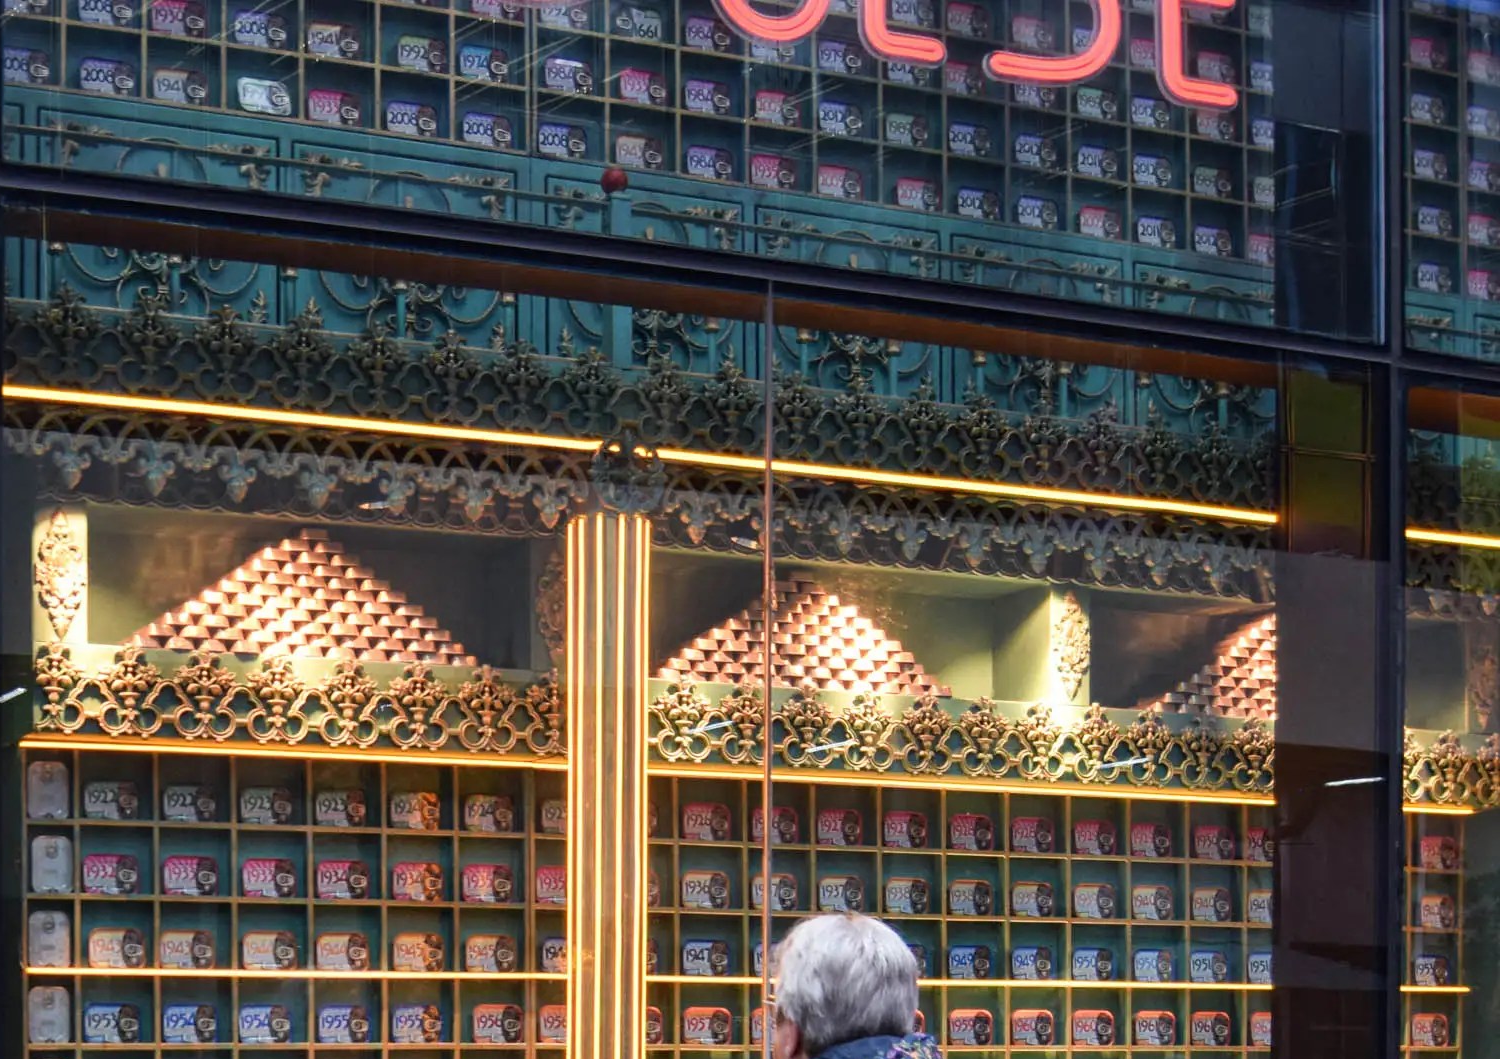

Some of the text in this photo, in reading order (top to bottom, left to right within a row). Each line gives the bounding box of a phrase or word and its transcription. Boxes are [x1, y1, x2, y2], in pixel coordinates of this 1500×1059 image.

[81, 0, 111, 12] 2008
[238, 21, 267, 35] 2008
[311, 32, 338, 44] 1941
[401, 44, 428, 60] 1992
[4, 59, 28, 72] 008
[462, 56, 489, 68] 1974
[84, 68, 114, 82] 2008
[156, 78, 186, 91] 1941
[687, 89, 713, 102] 1984
[390, 112, 418, 125] 2008
[821, 108, 845, 124] 2012
[465, 122, 494, 135] 2008
[540, 133, 568, 146] 2008
[951, 130, 973, 144] 2012
[1017, 142, 1039, 155] 2012
[689, 155, 714, 169] 1984
[1135, 163, 1157, 176] 2012
[959, 196, 982, 209] 2012
[1019, 205, 1041, 218] 2012
[88, 789, 117, 804] 1922
[167, 790, 196, 806] 1922
[318, 798, 347, 813] 1923
[394, 800, 419, 815] 1924
[467, 801, 494, 817] 1924
[686, 814, 711, 828] 1926
[754, 816, 779, 831] 196
[820, 817, 842, 832] 1927
[86, 864, 116, 879] 1932
[321, 871, 348, 885] 1934
[396, 872, 422, 886] 1934
[467, 872, 493, 886] 1935
[685, 879, 709, 895] 1936
[754, 883, 778, 897] 197
[821, 883, 845, 897] 1937
[686, 948, 710, 962] 1947
[952, 954, 974, 967] 1949
[1014, 954, 1035, 967] 1949
[1075, 957, 1097, 968] 1950
[1193, 958, 1211, 971] 1951
[1251, 960, 1268, 973] 1951
[87, 1013, 118, 1028] 1953
[166, 1012, 195, 1026] 1954
[241, 1013, 269, 1029] 1954
[321, 1015, 348, 1028] 1955
[396, 1015, 422, 1028] 1955
[477, 1014, 502, 1029] 1956
[687, 1017, 711, 1031] 1957
[952, 1019, 974, 1031] 1959
[1015, 1019, 1036, 1031] 1960
[1075, 1019, 1097, 1031] 1960
[1139, 1020, 1158, 1032] 1961
[1194, 1020, 1213, 1032] 1961
